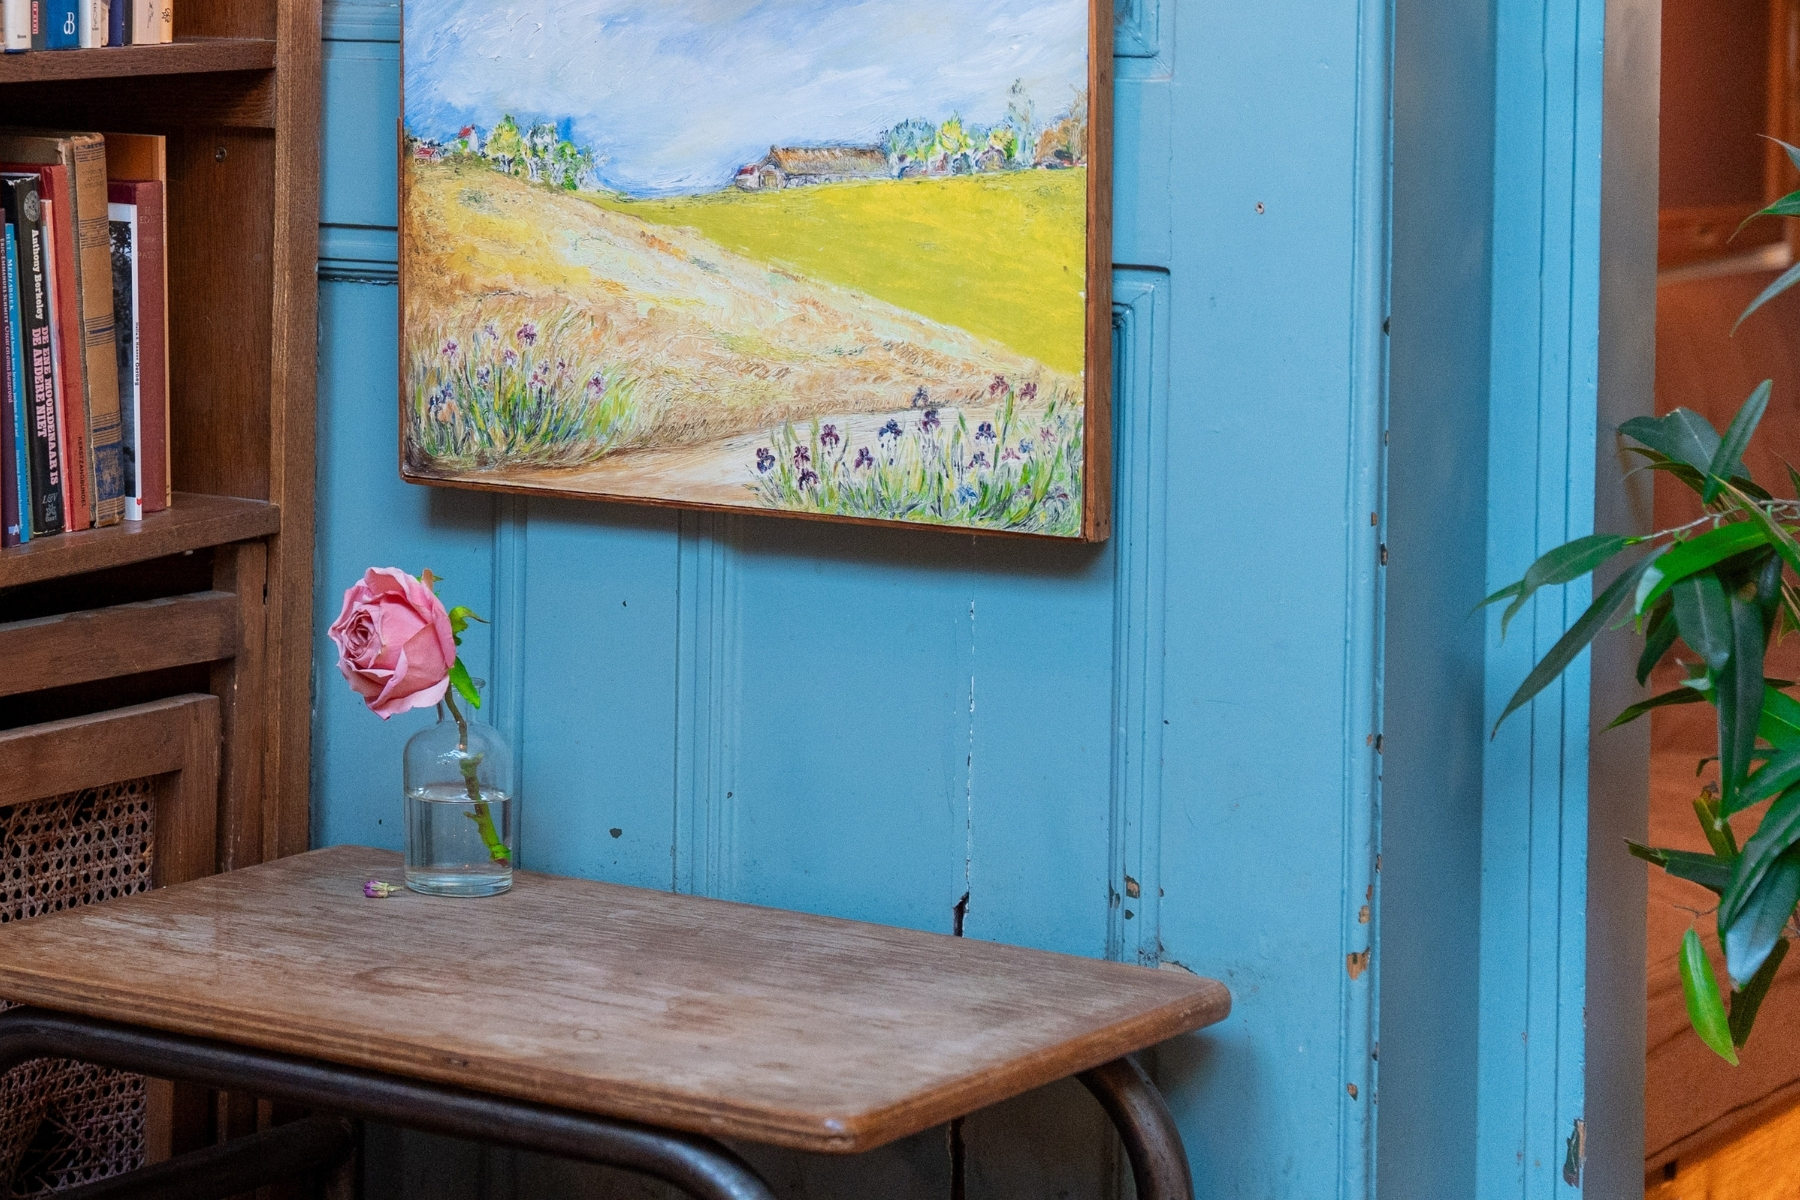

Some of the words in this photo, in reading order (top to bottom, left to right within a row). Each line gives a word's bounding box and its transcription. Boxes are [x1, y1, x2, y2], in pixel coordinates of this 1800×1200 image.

[30, 229, 41, 272] Anthony
[31, 274, 44, 320] Berkeley
[31, 328, 42, 347] DE
[40, 328, 49, 343] DE
[33, 349, 45, 403] ANDERE
[42, 347, 51, 377] ENE
[36, 405, 48, 438] NIET
[43, 379, 56, 465] MOORDENAAR
[49, 469, 58, 485] IS
[77, 436, 87, 508] KERSTZANGBUNDEL
